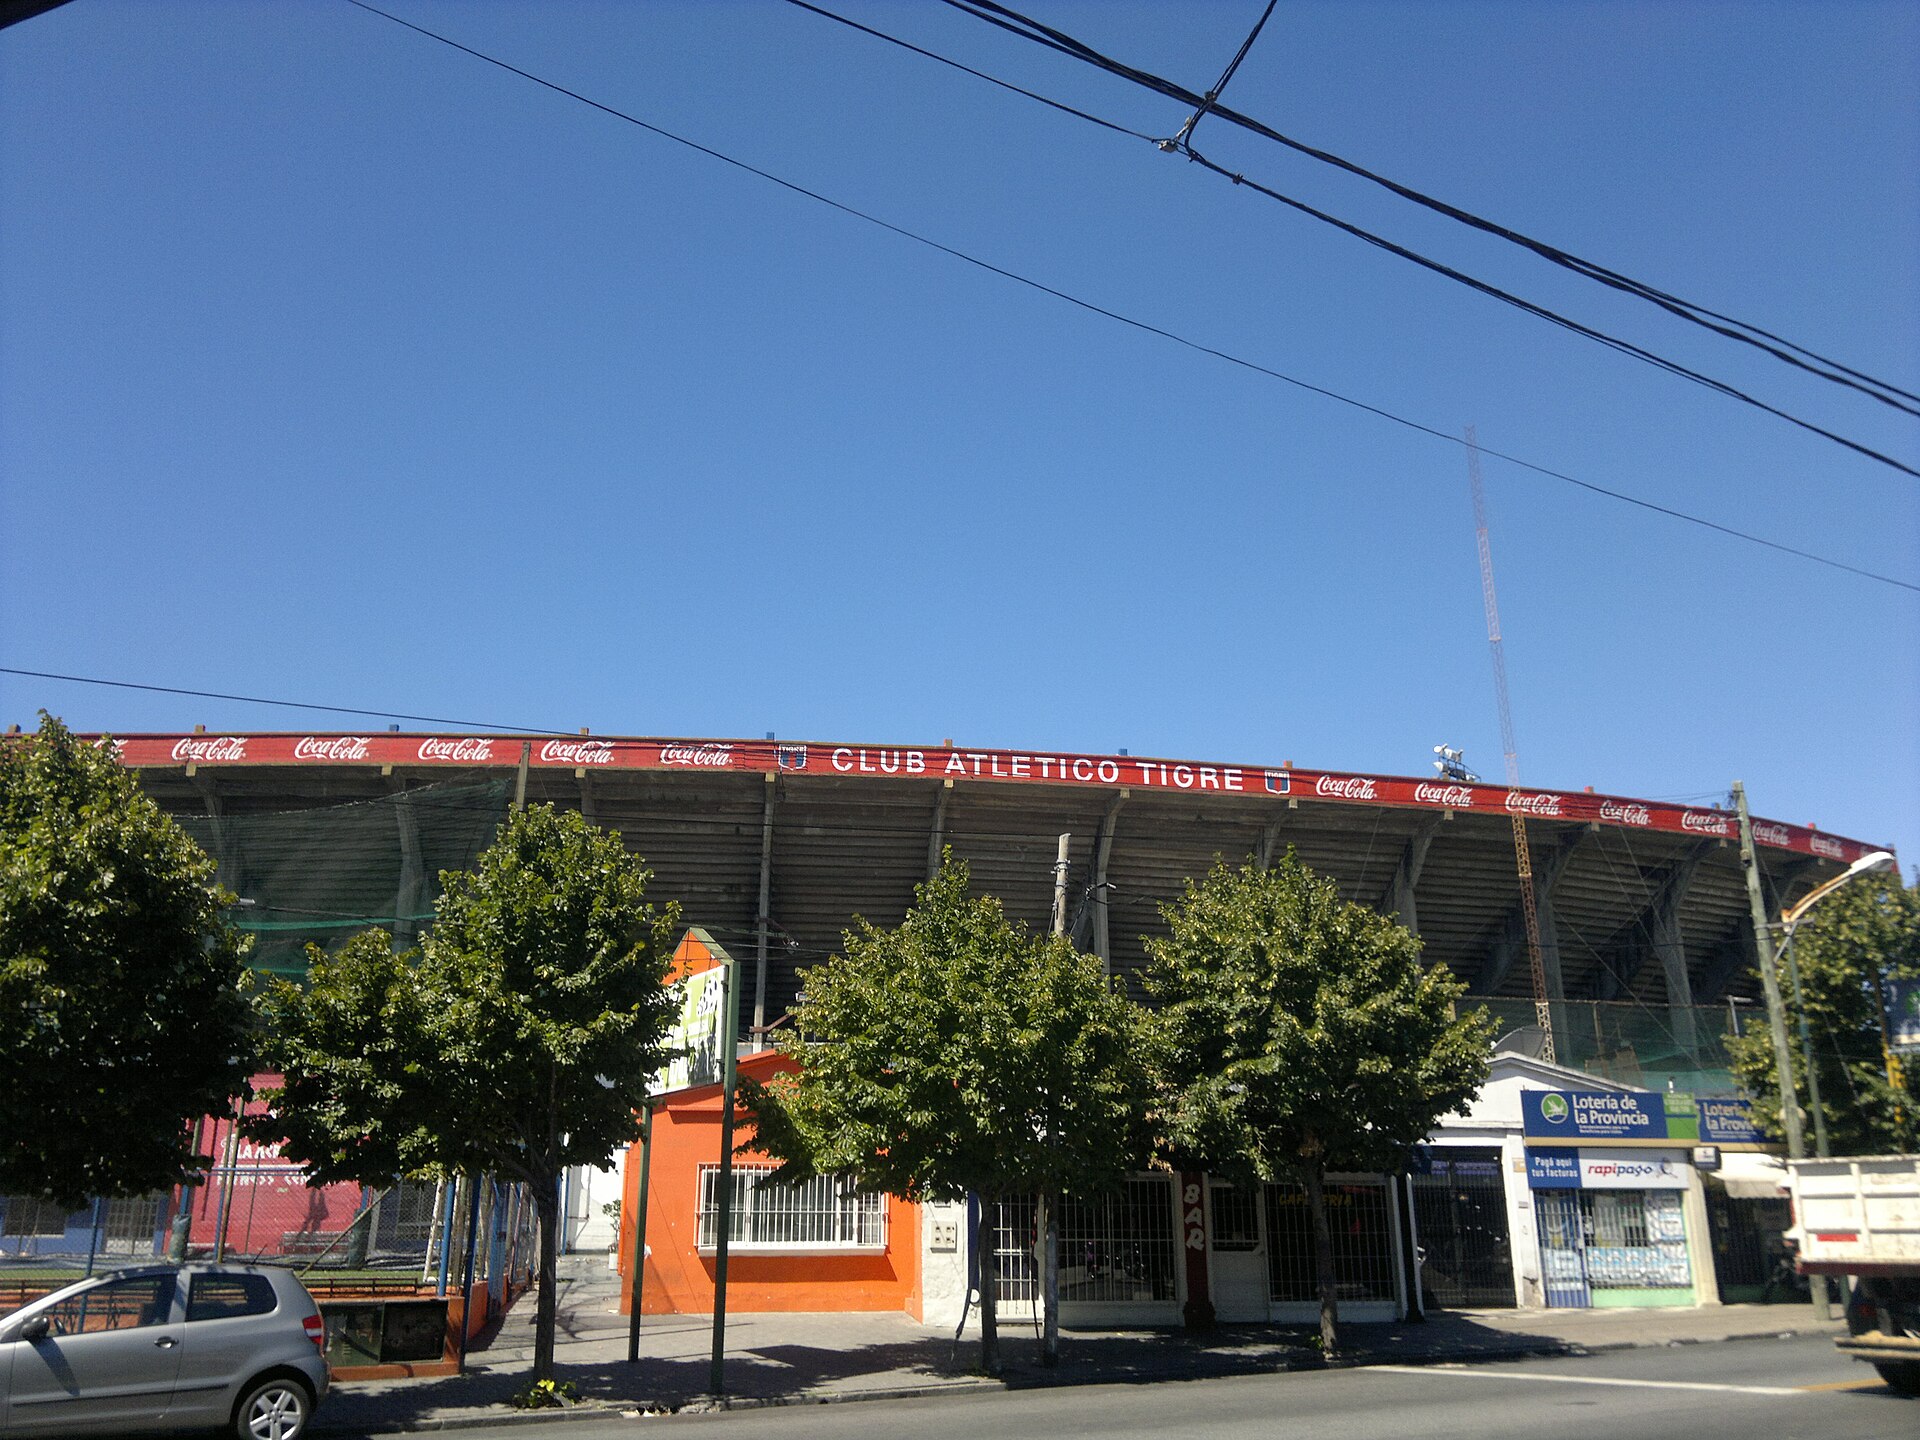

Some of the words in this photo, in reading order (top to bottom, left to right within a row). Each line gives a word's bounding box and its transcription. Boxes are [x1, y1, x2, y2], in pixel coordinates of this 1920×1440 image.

[831, 748, 925, 774] CLUB
[944, 752, 1119, 783] ATLETICO
[1135, 762, 1243, 791] TIGRE
[1572, 1094, 1617, 1109] Lotería
[1620, 1095, 1637, 1109] de
[1574, 1111, 1587, 1124] la
[1590, 1110, 1649, 1125] Provincia
[1705, 1116, 1719, 1130] la
[1531, 1168, 1545, 1177] tus
[1546, 1167, 1579, 1178] facturas
[1587, 1163, 1653, 1178] rapipago
[1184, 1183, 1205, 1251] BAR
